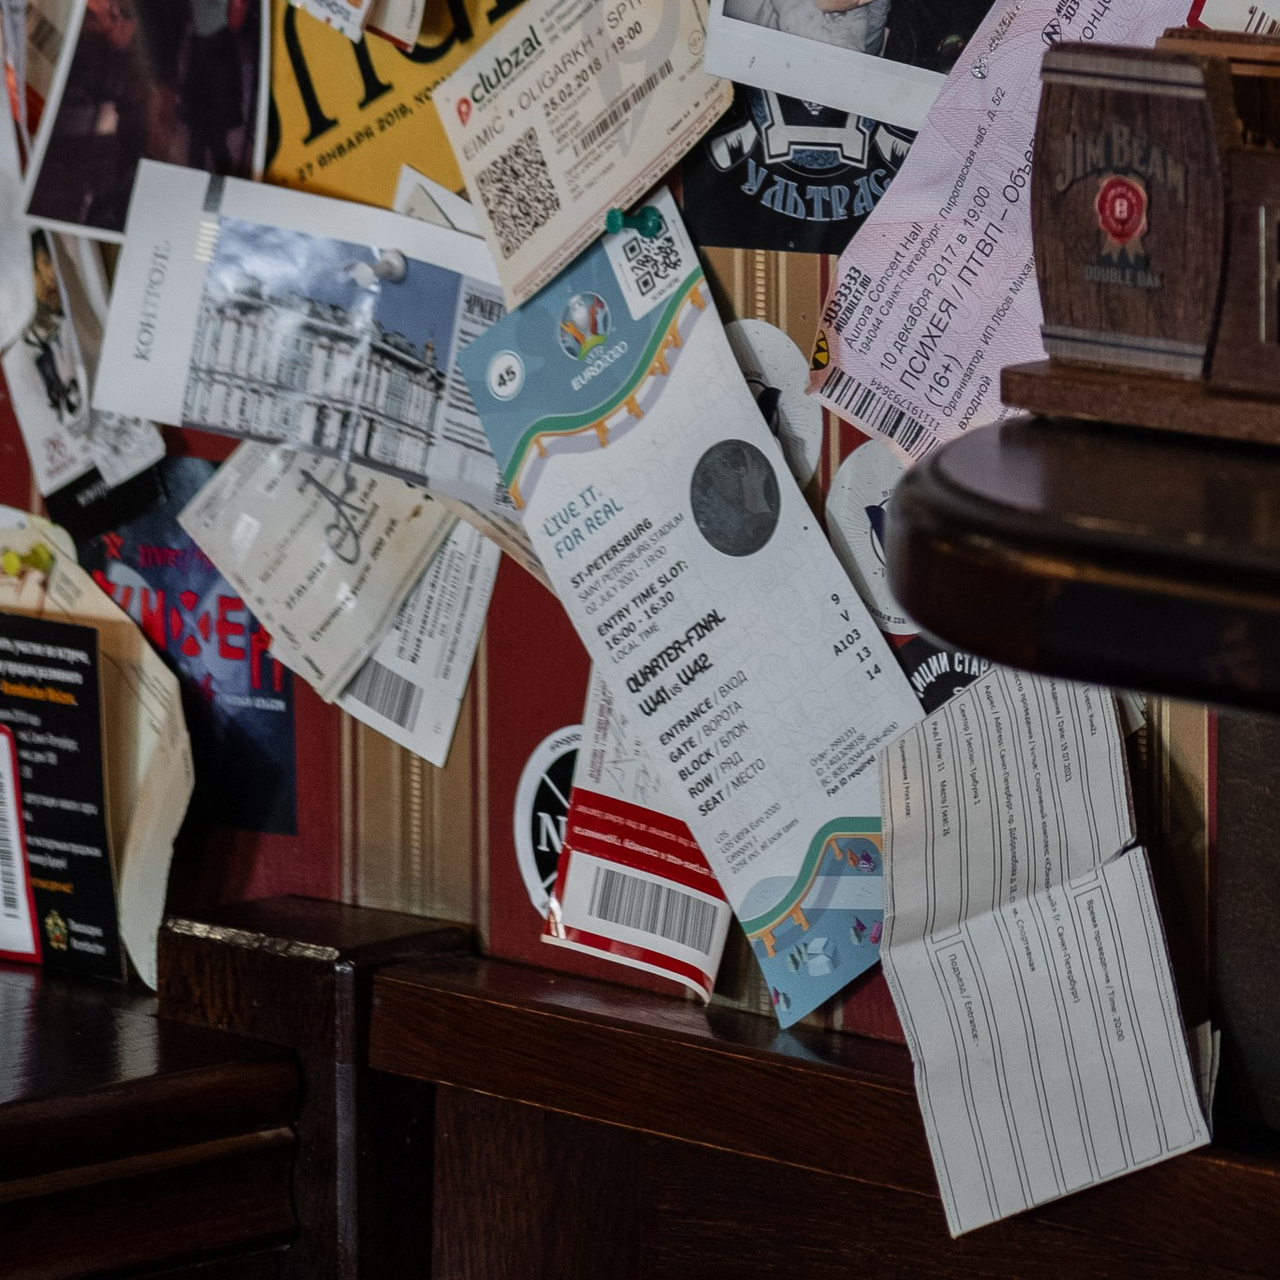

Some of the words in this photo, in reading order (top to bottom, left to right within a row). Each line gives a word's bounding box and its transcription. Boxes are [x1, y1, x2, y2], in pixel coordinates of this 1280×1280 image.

[470, 24, 545, 106] clubzal
[610, 19, 645, 56] 19:00
[461, 112, 506, 162] EIMIC
[517, 34, 596, 112] OLIGARKH
[856, 316, 883, 358] 194044
[880, 220, 944, 319] Санкт-Петербург,
[938, 150, 978, 224] Пироговская
[879, 350, 898, 373] 10
[893, 286, 935, 354] декабря
[926, 244, 960, 287] 2017
[962, 185, 992, 231] 19:00
[1083, 264, 1132, 286] DOUBLE
[834, 274, 874, 336] MUZBILET.RU
[844, 305, 875, 351] Aurora
[871, 250, 906, 310] Concert
[901, 221, 925, 260] Hall
[899, 300, 960, 391] ПСИХЕЯ
[956, 225, 1004, 289] ПТВП
[494, 364, 519, 390] 45
[922, 352, 965, 408] (16+)
[542, 500, 582, 538] LIVE
[554, 527, 587, 561] FOR
[584, 496, 625, 537] REAL
[569, 516, 654, 591] ST-PETERSBURG
[596, 599, 633, 638] ENTRY
[656, 558, 691, 588] SLOT:
[604, 622, 638, 652] 16:00
[644, 590, 676, 622] 16:30
[625, 608, 728, 695] QUARTER-FINAL
[854, 645, 874, 664] 13
[864, 662, 883, 682] 14
[658, 698, 715, 748] ENTRANCE
[668, 734, 698, 765] GATE
[677, 748, 716, 783] BLOCK
[686, 773, 715, 801] ROW
[698, 790, 727, 819] SEAT
[729, 757, 767, 791] МЕСТО
[947, 953, 969, 1002] Подъезд
[1091, 928, 1113, 988] проведения
[1112, 1016, 1126, 1044] 20:00
